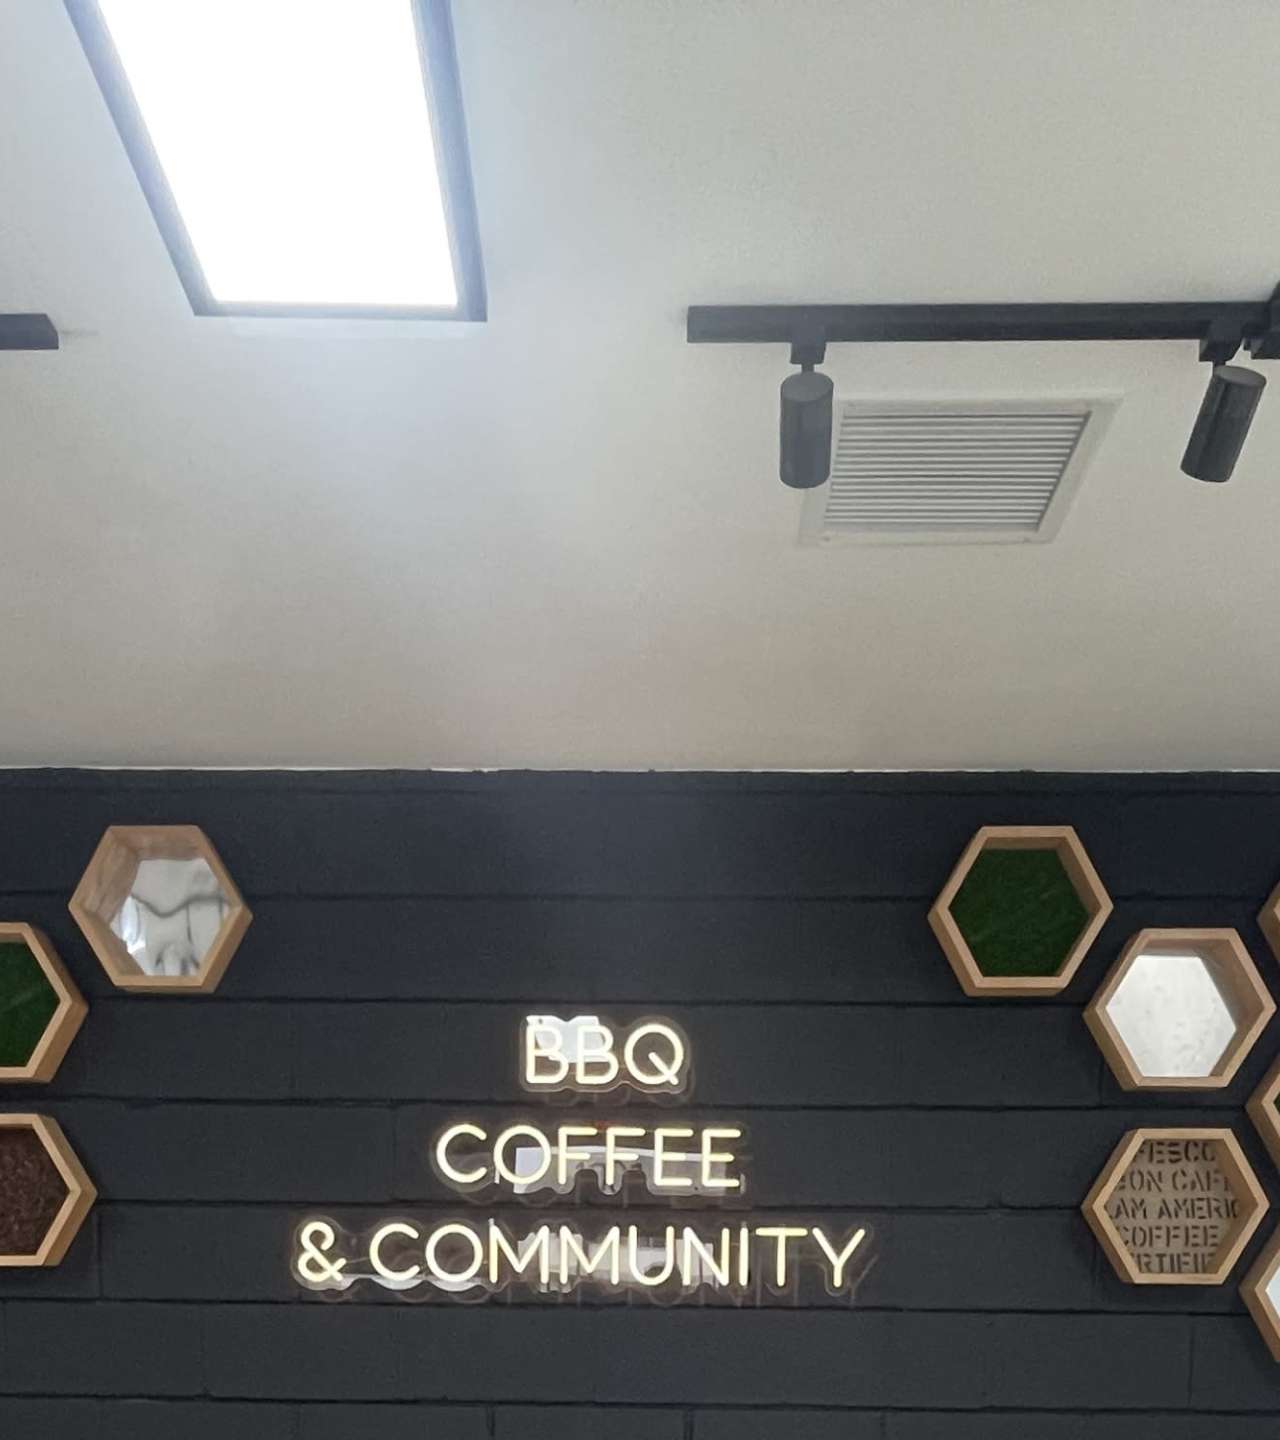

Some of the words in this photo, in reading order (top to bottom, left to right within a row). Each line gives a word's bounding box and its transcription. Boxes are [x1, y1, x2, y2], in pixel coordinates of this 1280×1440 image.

[525, 1022, 684, 1086] BBQ
[435, 1123, 741, 1188] COFFEE
[297, 1221, 347, 1283] &
[369, 1222, 867, 1288] COMMUNITY
[1131, 1253, 1218, 1273] RTIFI
